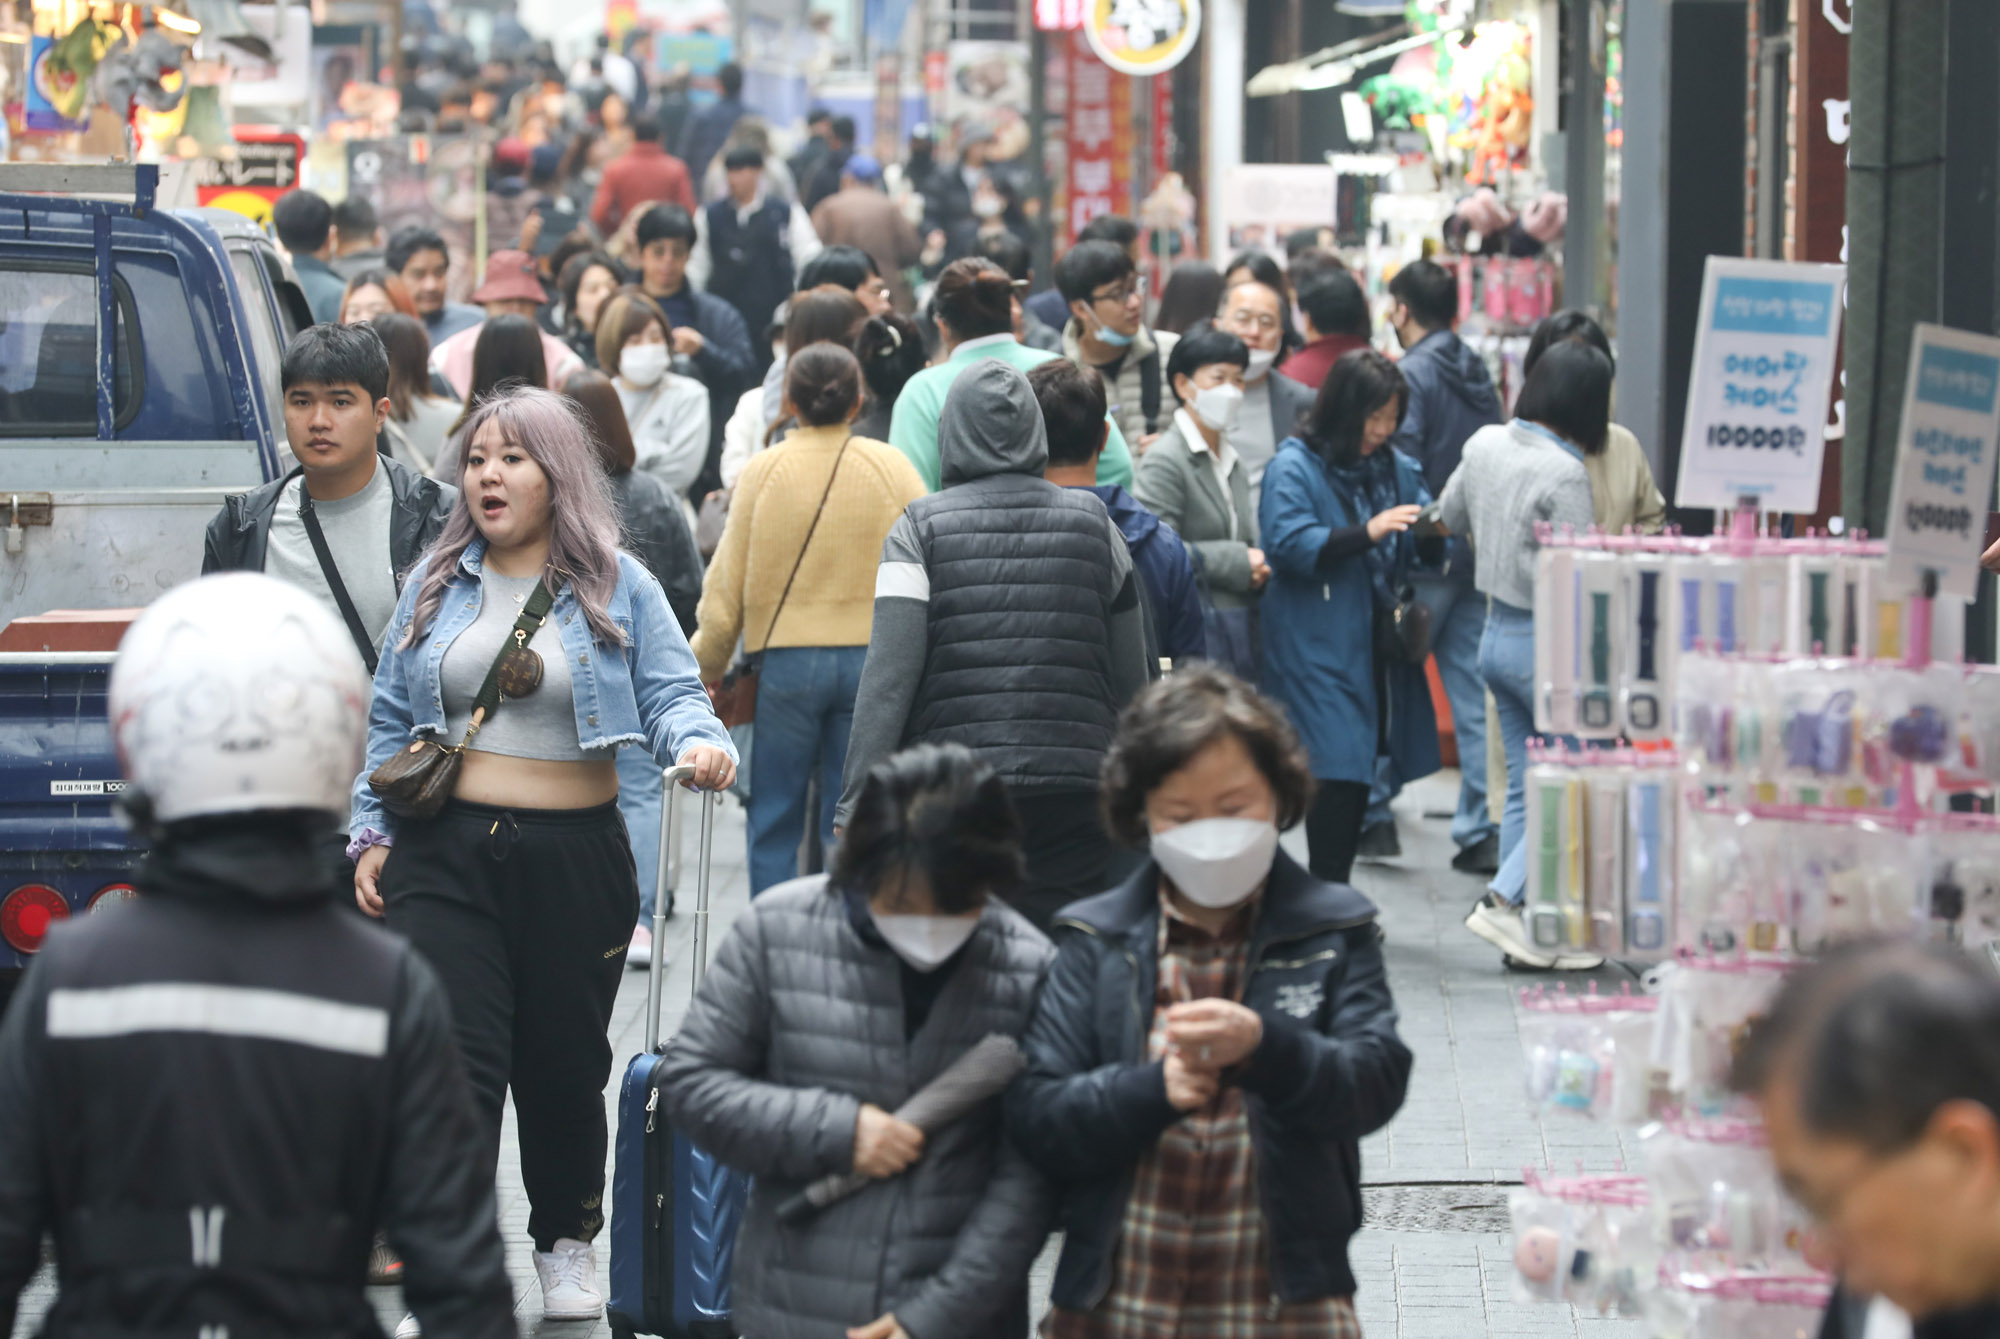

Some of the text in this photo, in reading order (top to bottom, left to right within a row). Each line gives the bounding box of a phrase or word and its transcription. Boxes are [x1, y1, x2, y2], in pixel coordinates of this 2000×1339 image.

[1724, 380, 1799, 414] 케이스
[1707, 424, 1806, 457] 10000원
[55, 784, 101, 792] 최대적재량
